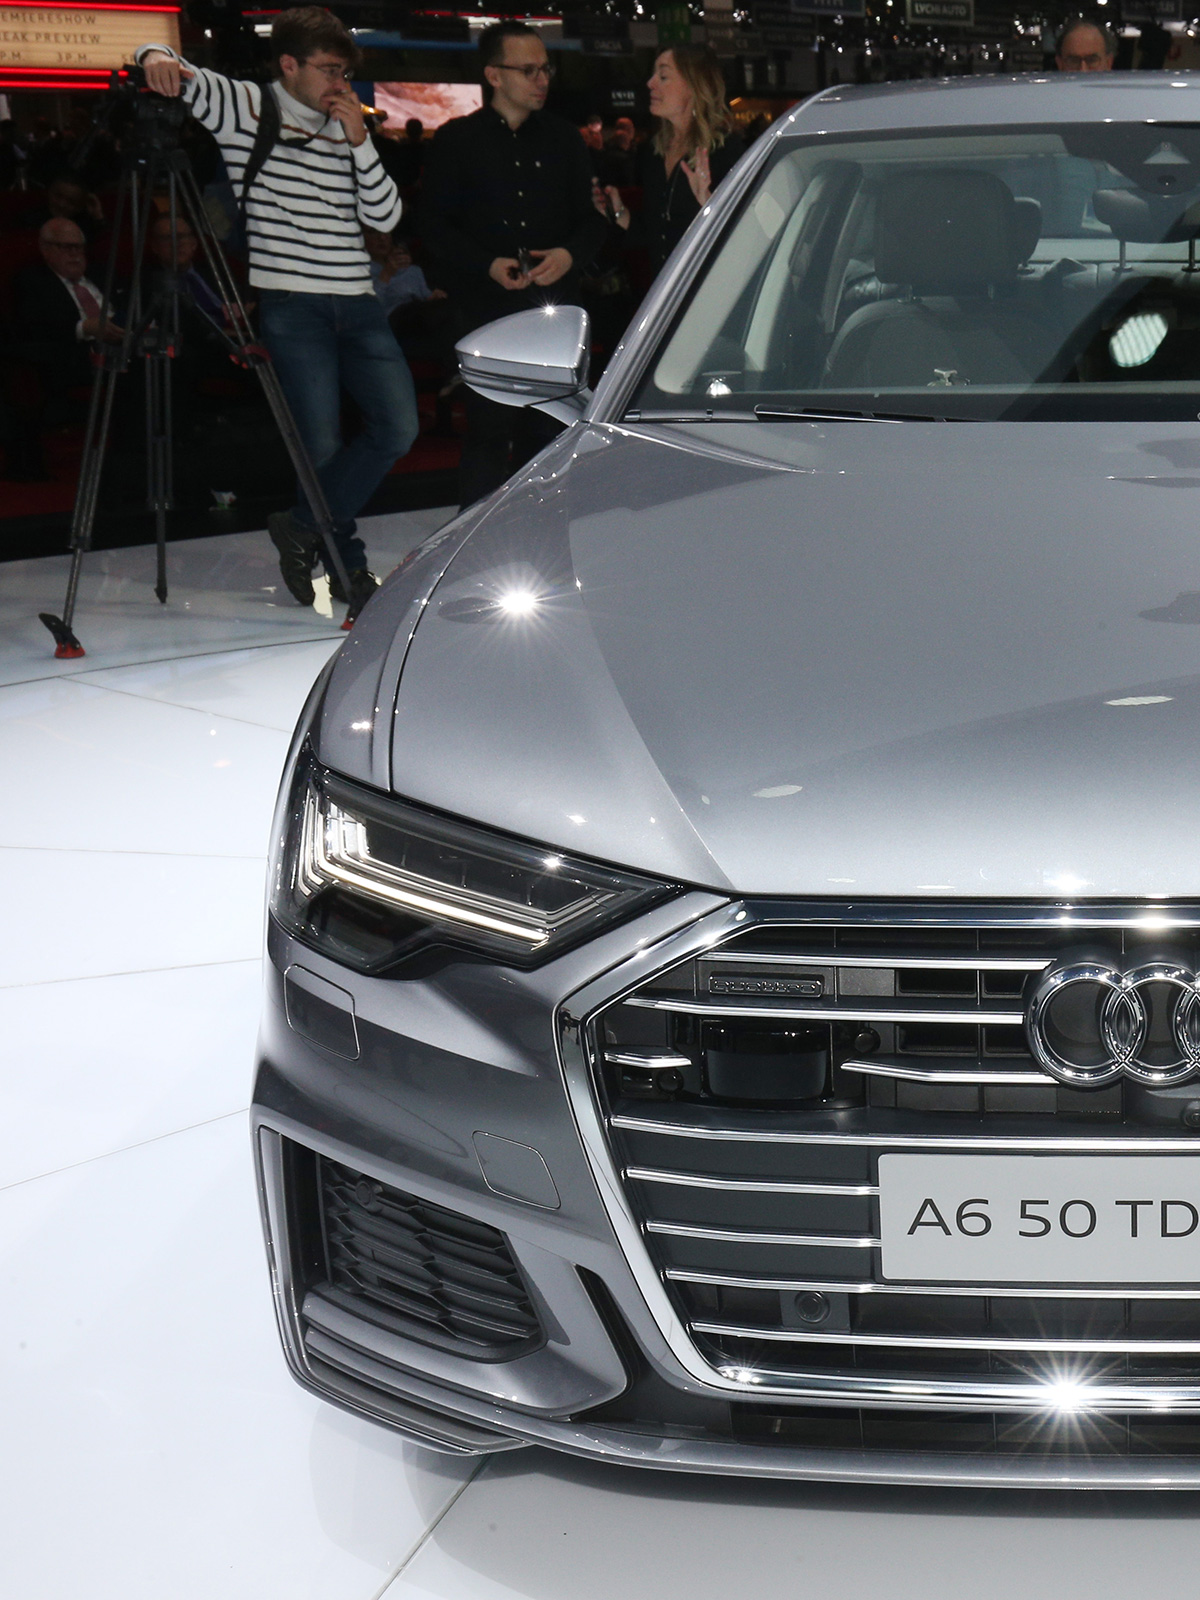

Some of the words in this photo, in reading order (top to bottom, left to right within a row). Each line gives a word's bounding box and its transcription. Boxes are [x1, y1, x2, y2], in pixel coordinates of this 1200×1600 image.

[0, 31, 28, 43] EAK
[35, 32, 100, 44] PREVIEW
[907, 1198, 992, 1237] A6
[1018, 1199, 1097, 1237] 50
